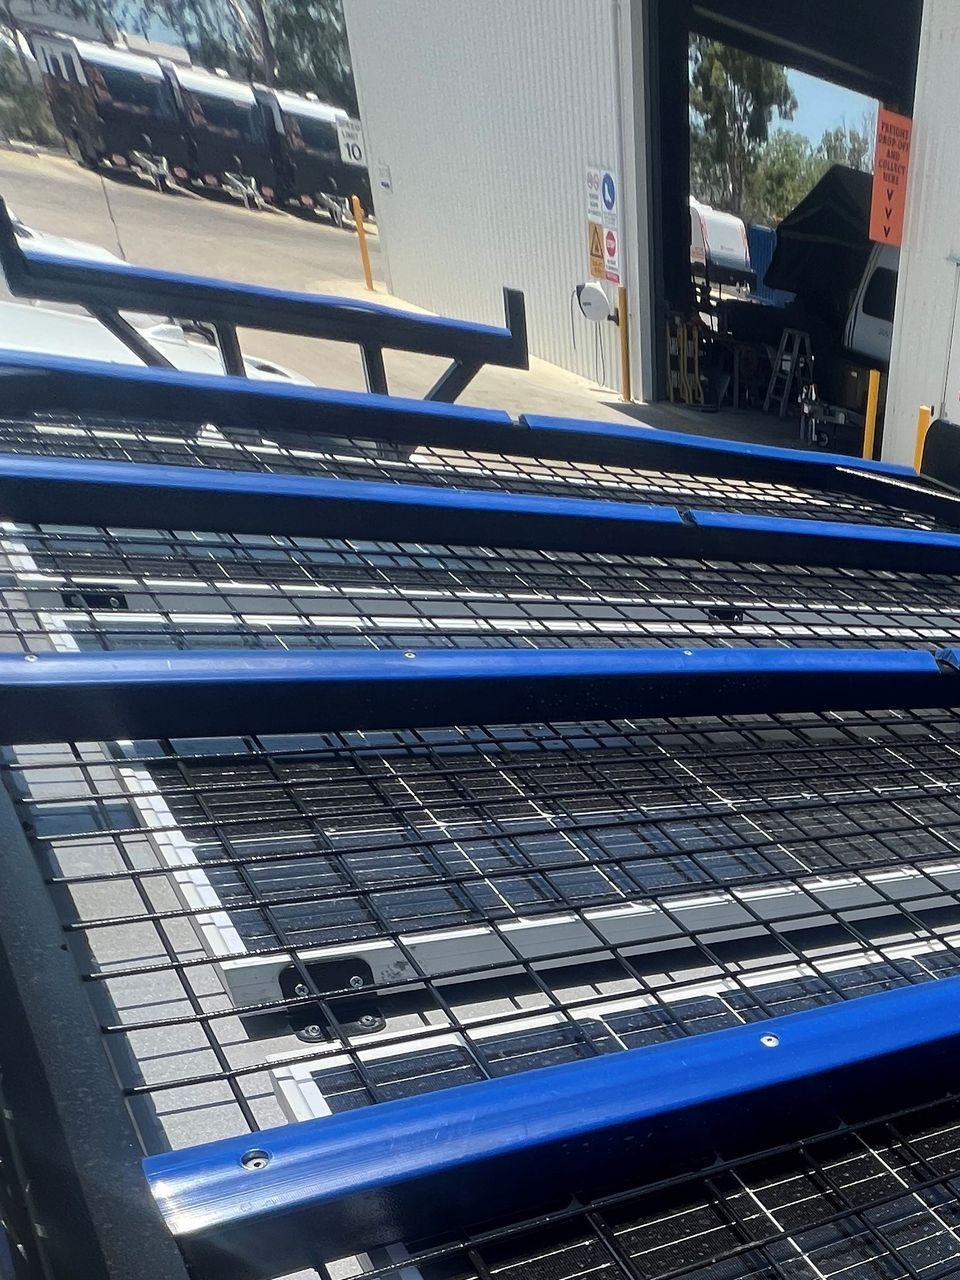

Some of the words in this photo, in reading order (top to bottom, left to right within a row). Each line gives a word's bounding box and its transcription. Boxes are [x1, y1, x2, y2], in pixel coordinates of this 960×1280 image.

[345, 143, 362, 160] 10
[887, 149, 900, 161] AND
[879, 160, 905, 175] COLLECT
